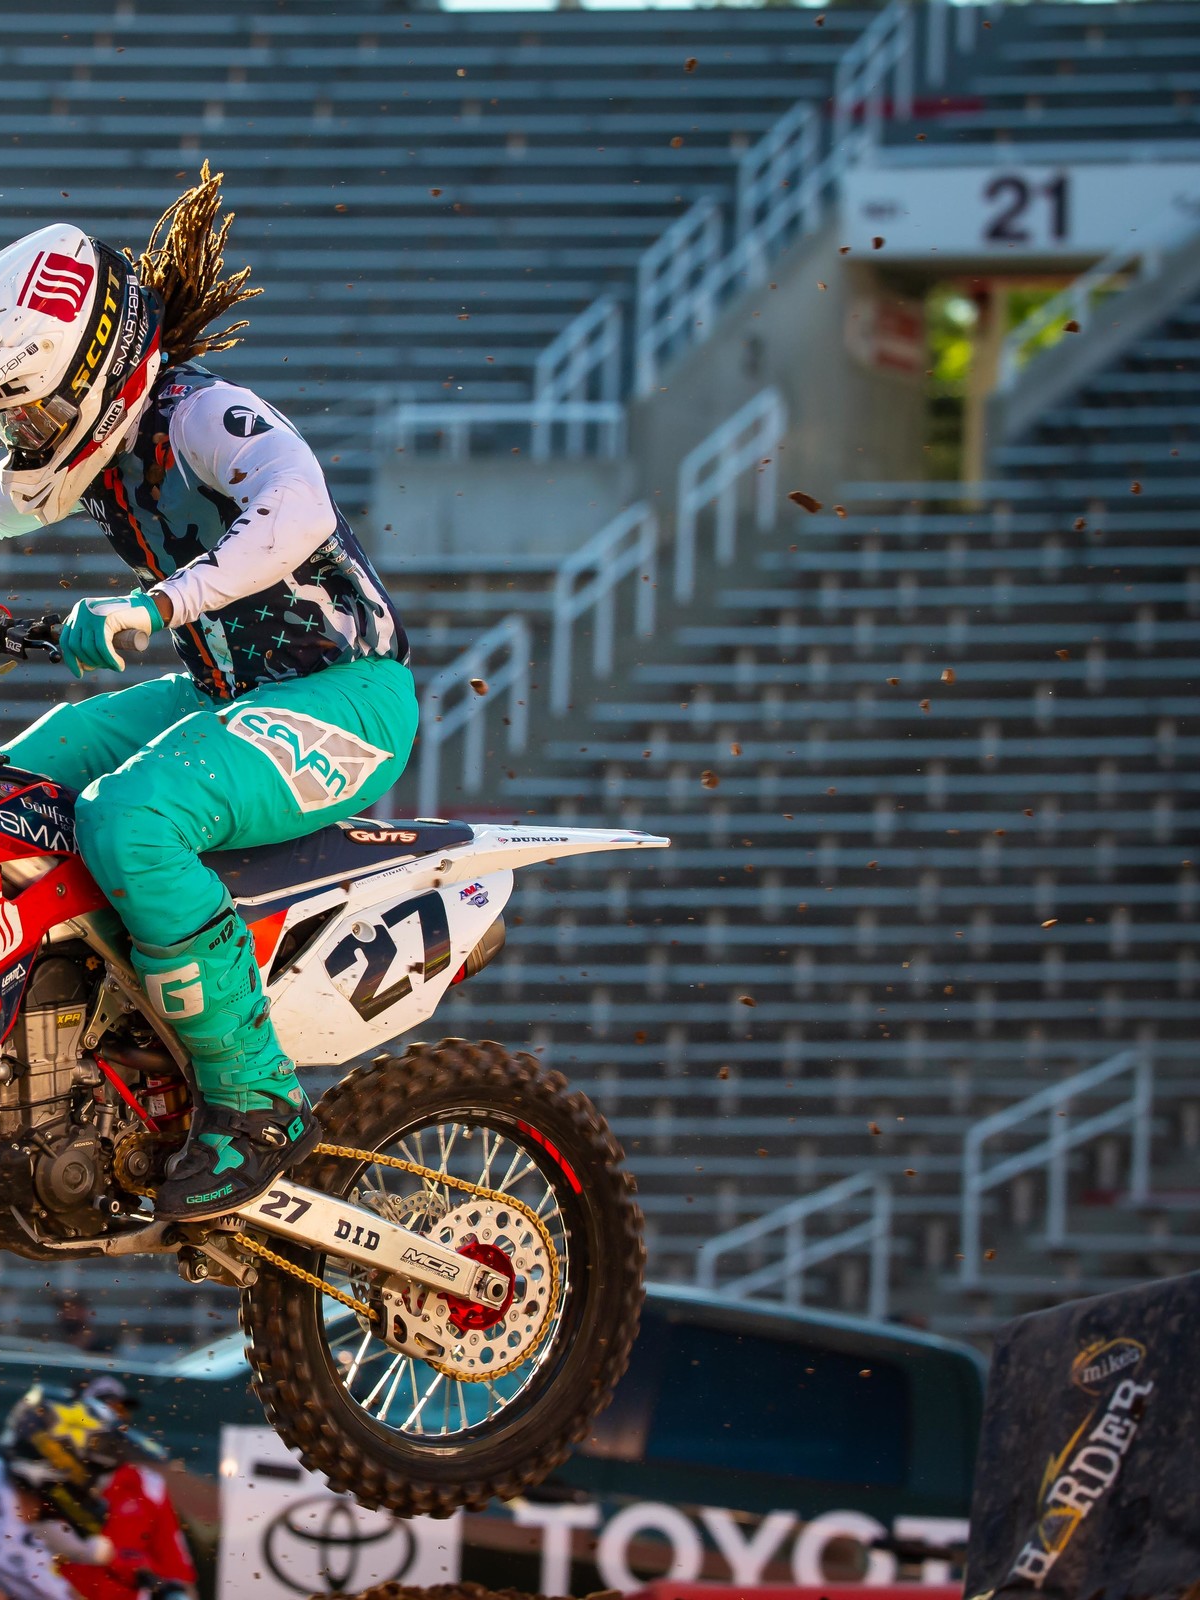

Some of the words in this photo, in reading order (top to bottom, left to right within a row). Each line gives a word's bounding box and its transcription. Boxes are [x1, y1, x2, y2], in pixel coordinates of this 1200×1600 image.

[982, 173, 1070, 243] 21
[71, 266, 120, 398] SCOTT
[97, 403, 123, 438] SHOEI
[240, 714, 347, 798] seven
[349, 830, 418, 843] GUTS
[325, 889, 451, 1023] 27
[259, 1190, 313, 1223] 27
[402, 1247, 460, 1278] MCR
